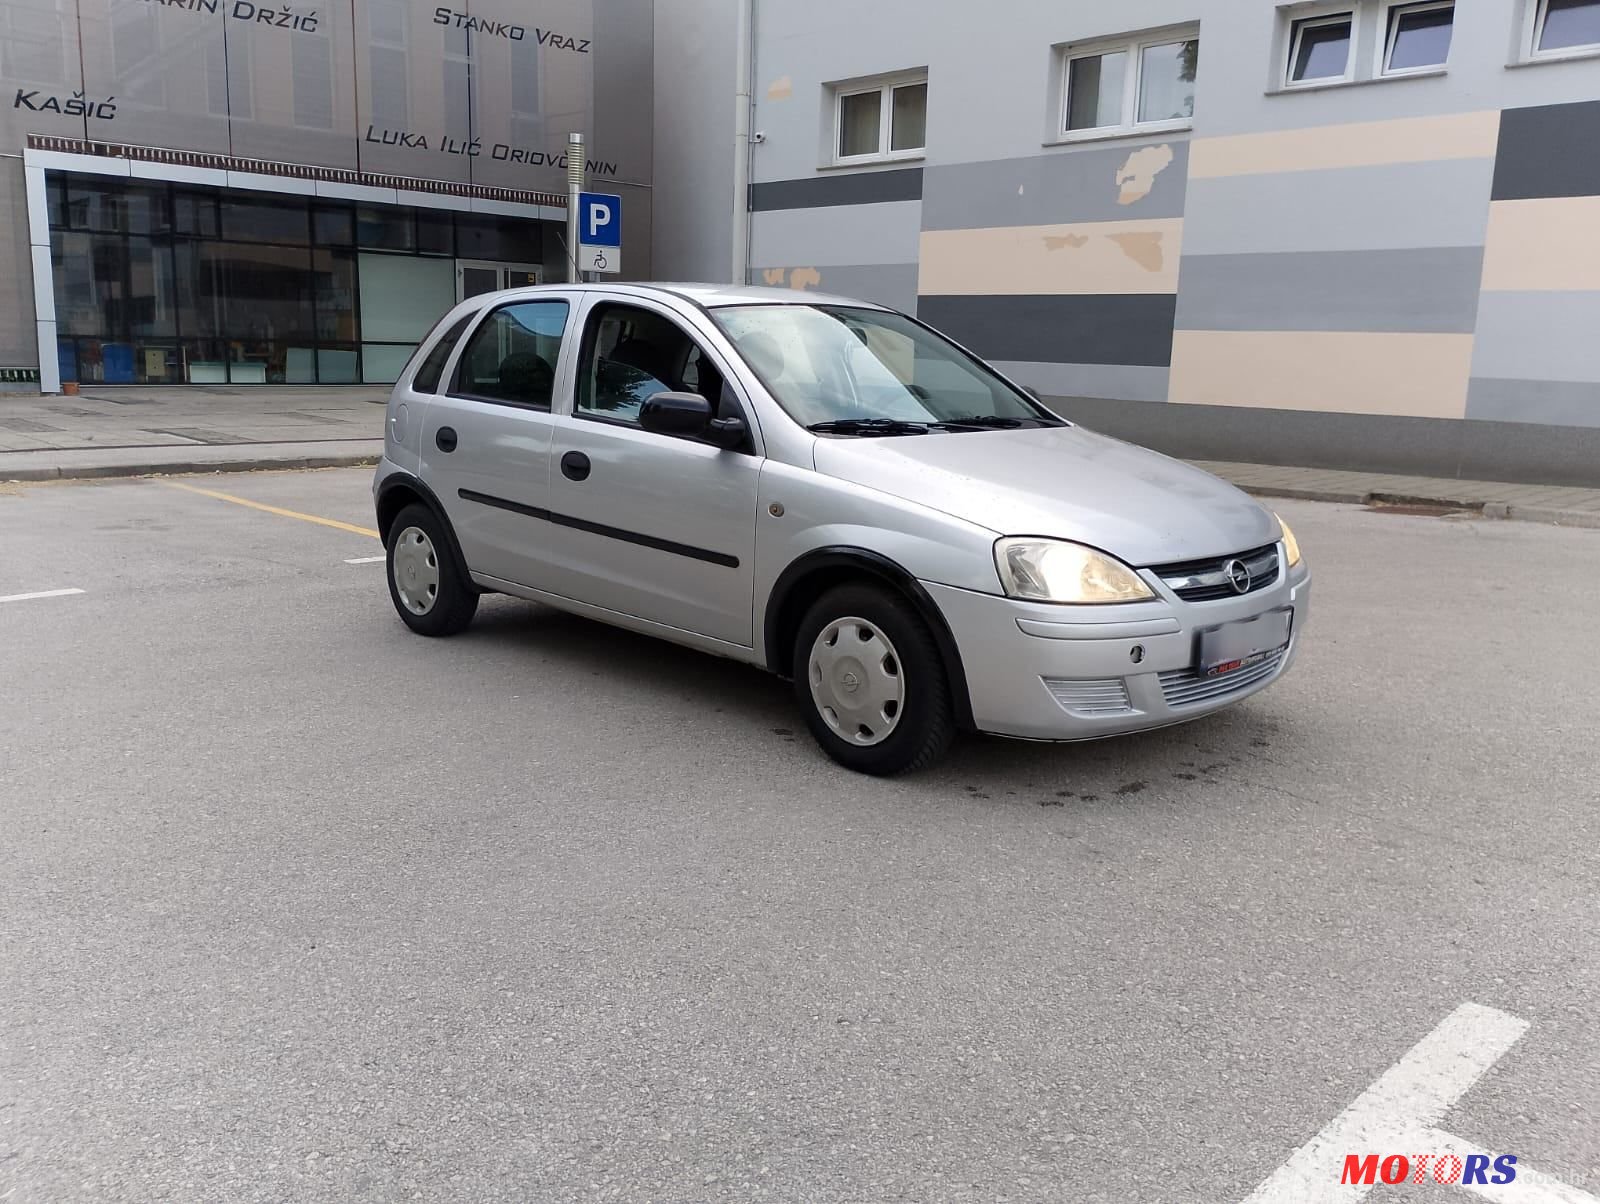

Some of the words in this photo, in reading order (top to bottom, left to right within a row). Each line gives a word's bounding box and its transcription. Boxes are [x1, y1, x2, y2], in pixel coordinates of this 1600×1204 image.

[232, 1, 318, 33] DRŽIĆ
[433, 7, 525, 41] STANKO
[536, 28, 591, 53] VRAZ
[14, 88, 117, 120] KAŠIĆ
[366, 125, 428, 150] LUKA
[440, 136, 482, 157] ILIĆ
[492, 143, 617, 176] ORIOVČNIN
[590, 203, 611, 236] P
